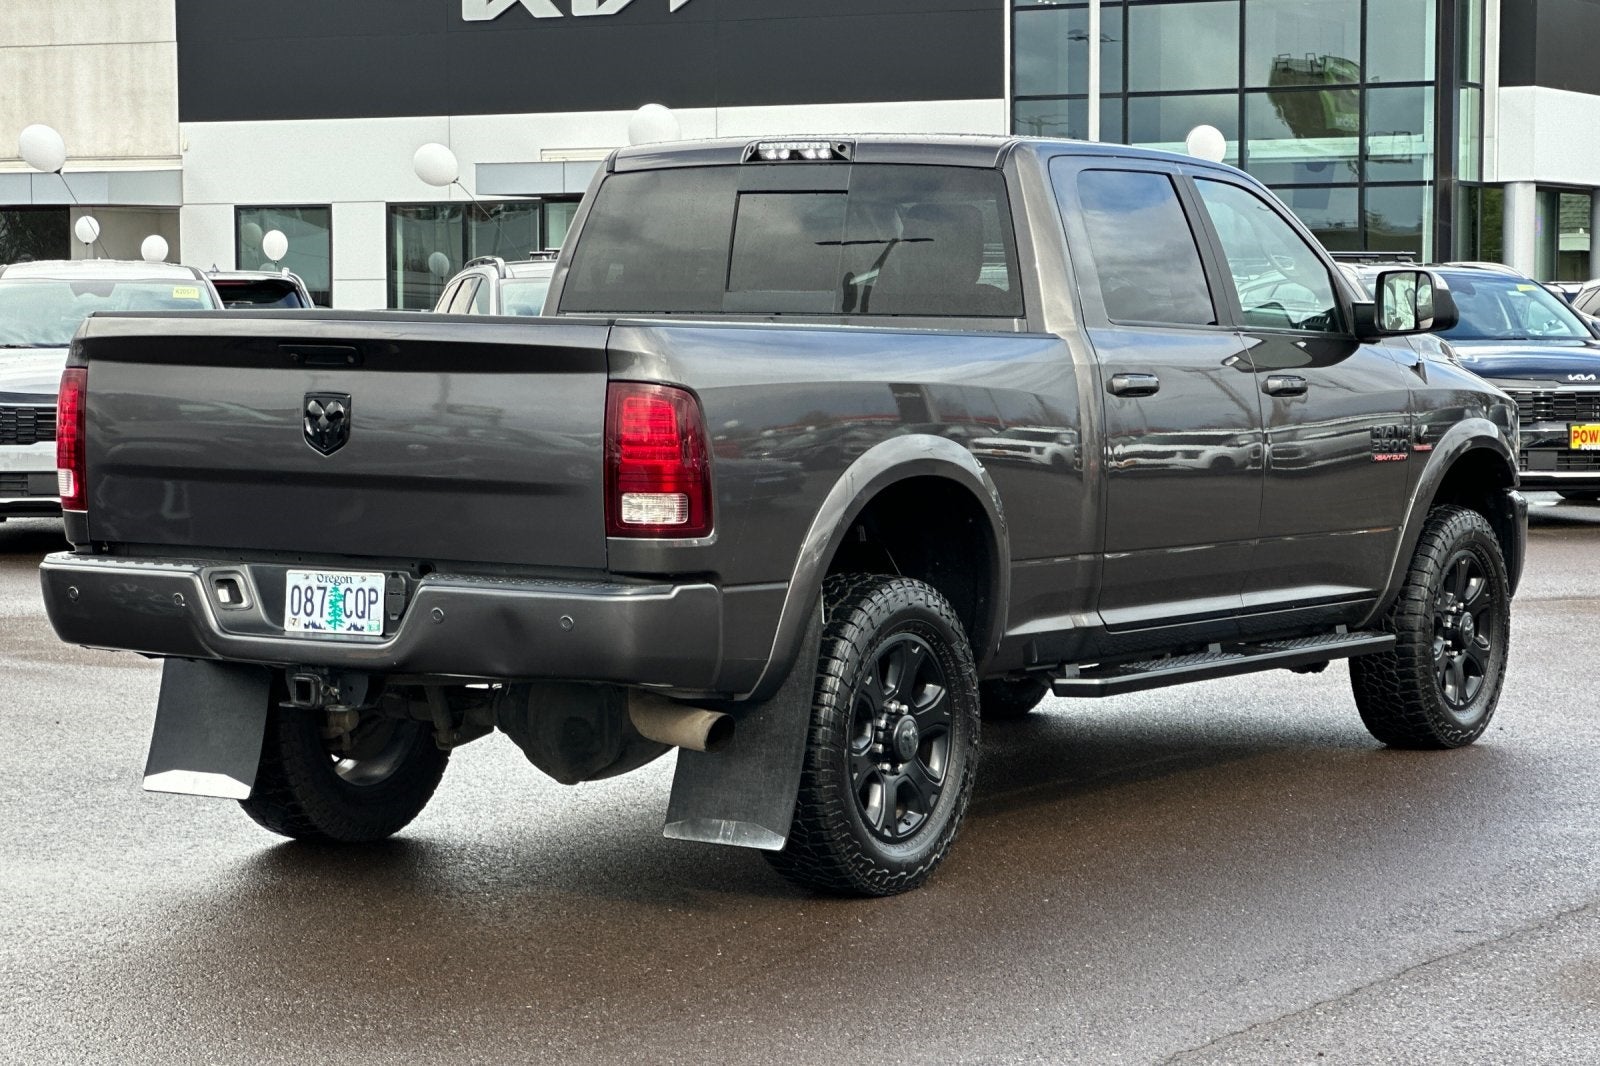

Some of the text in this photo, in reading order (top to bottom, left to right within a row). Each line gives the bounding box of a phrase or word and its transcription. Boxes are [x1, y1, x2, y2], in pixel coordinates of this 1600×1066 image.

[1573, 430, 1600, 443] POW
[316, 574, 353, 586] Oregon
[290, 585, 379, 621] 087 CQP
